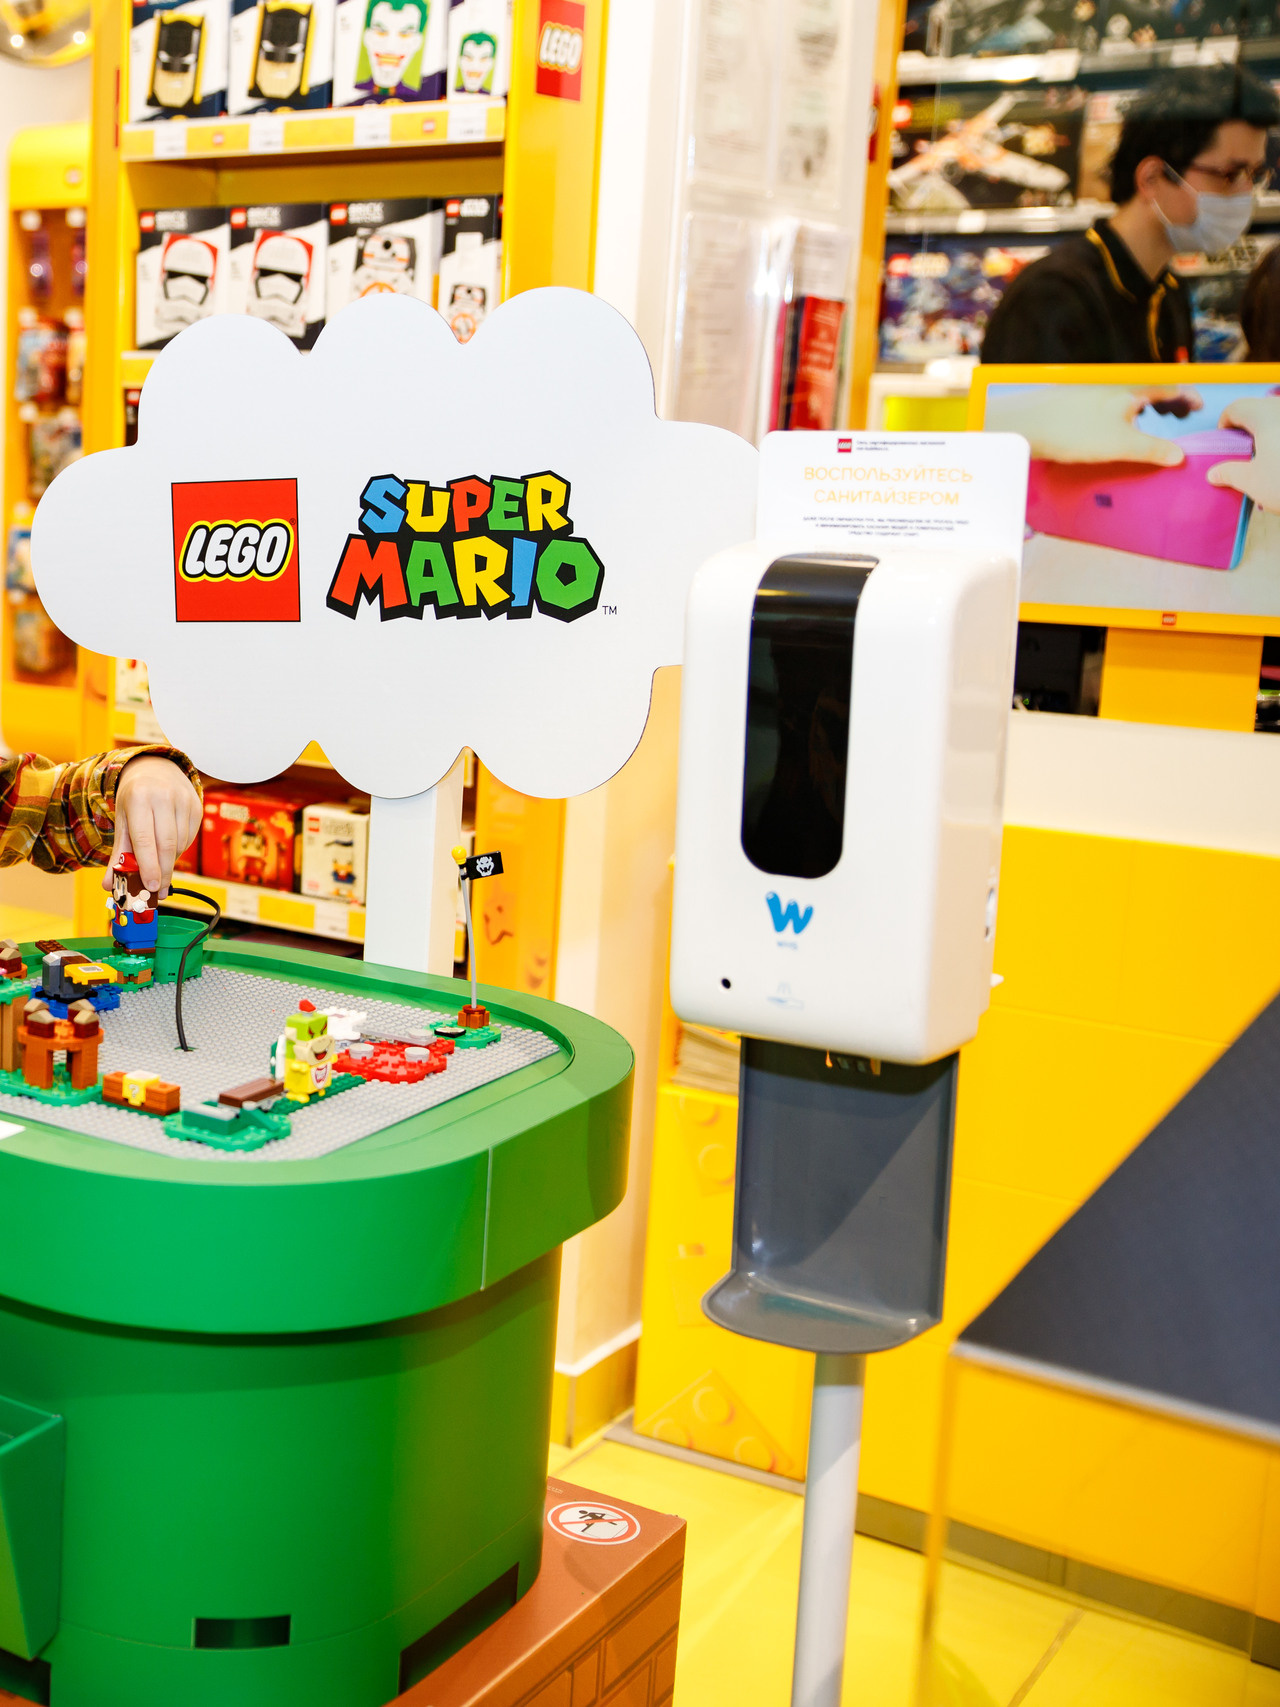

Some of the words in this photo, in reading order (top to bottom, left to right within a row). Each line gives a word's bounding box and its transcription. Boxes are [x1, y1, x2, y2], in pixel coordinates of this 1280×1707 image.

[539, 23, 583, 71] LEGO
[804, 464, 973, 483] ВОСПОЛЬЗУЙТЕСЬ
[814, 487, 960, 506] САНИТАЙЗЕРОМ
[359, 470, 573, 534] SUPER
[181, 521, 291, 579] LEGO
[327, 533, 605, 623] MARIO
